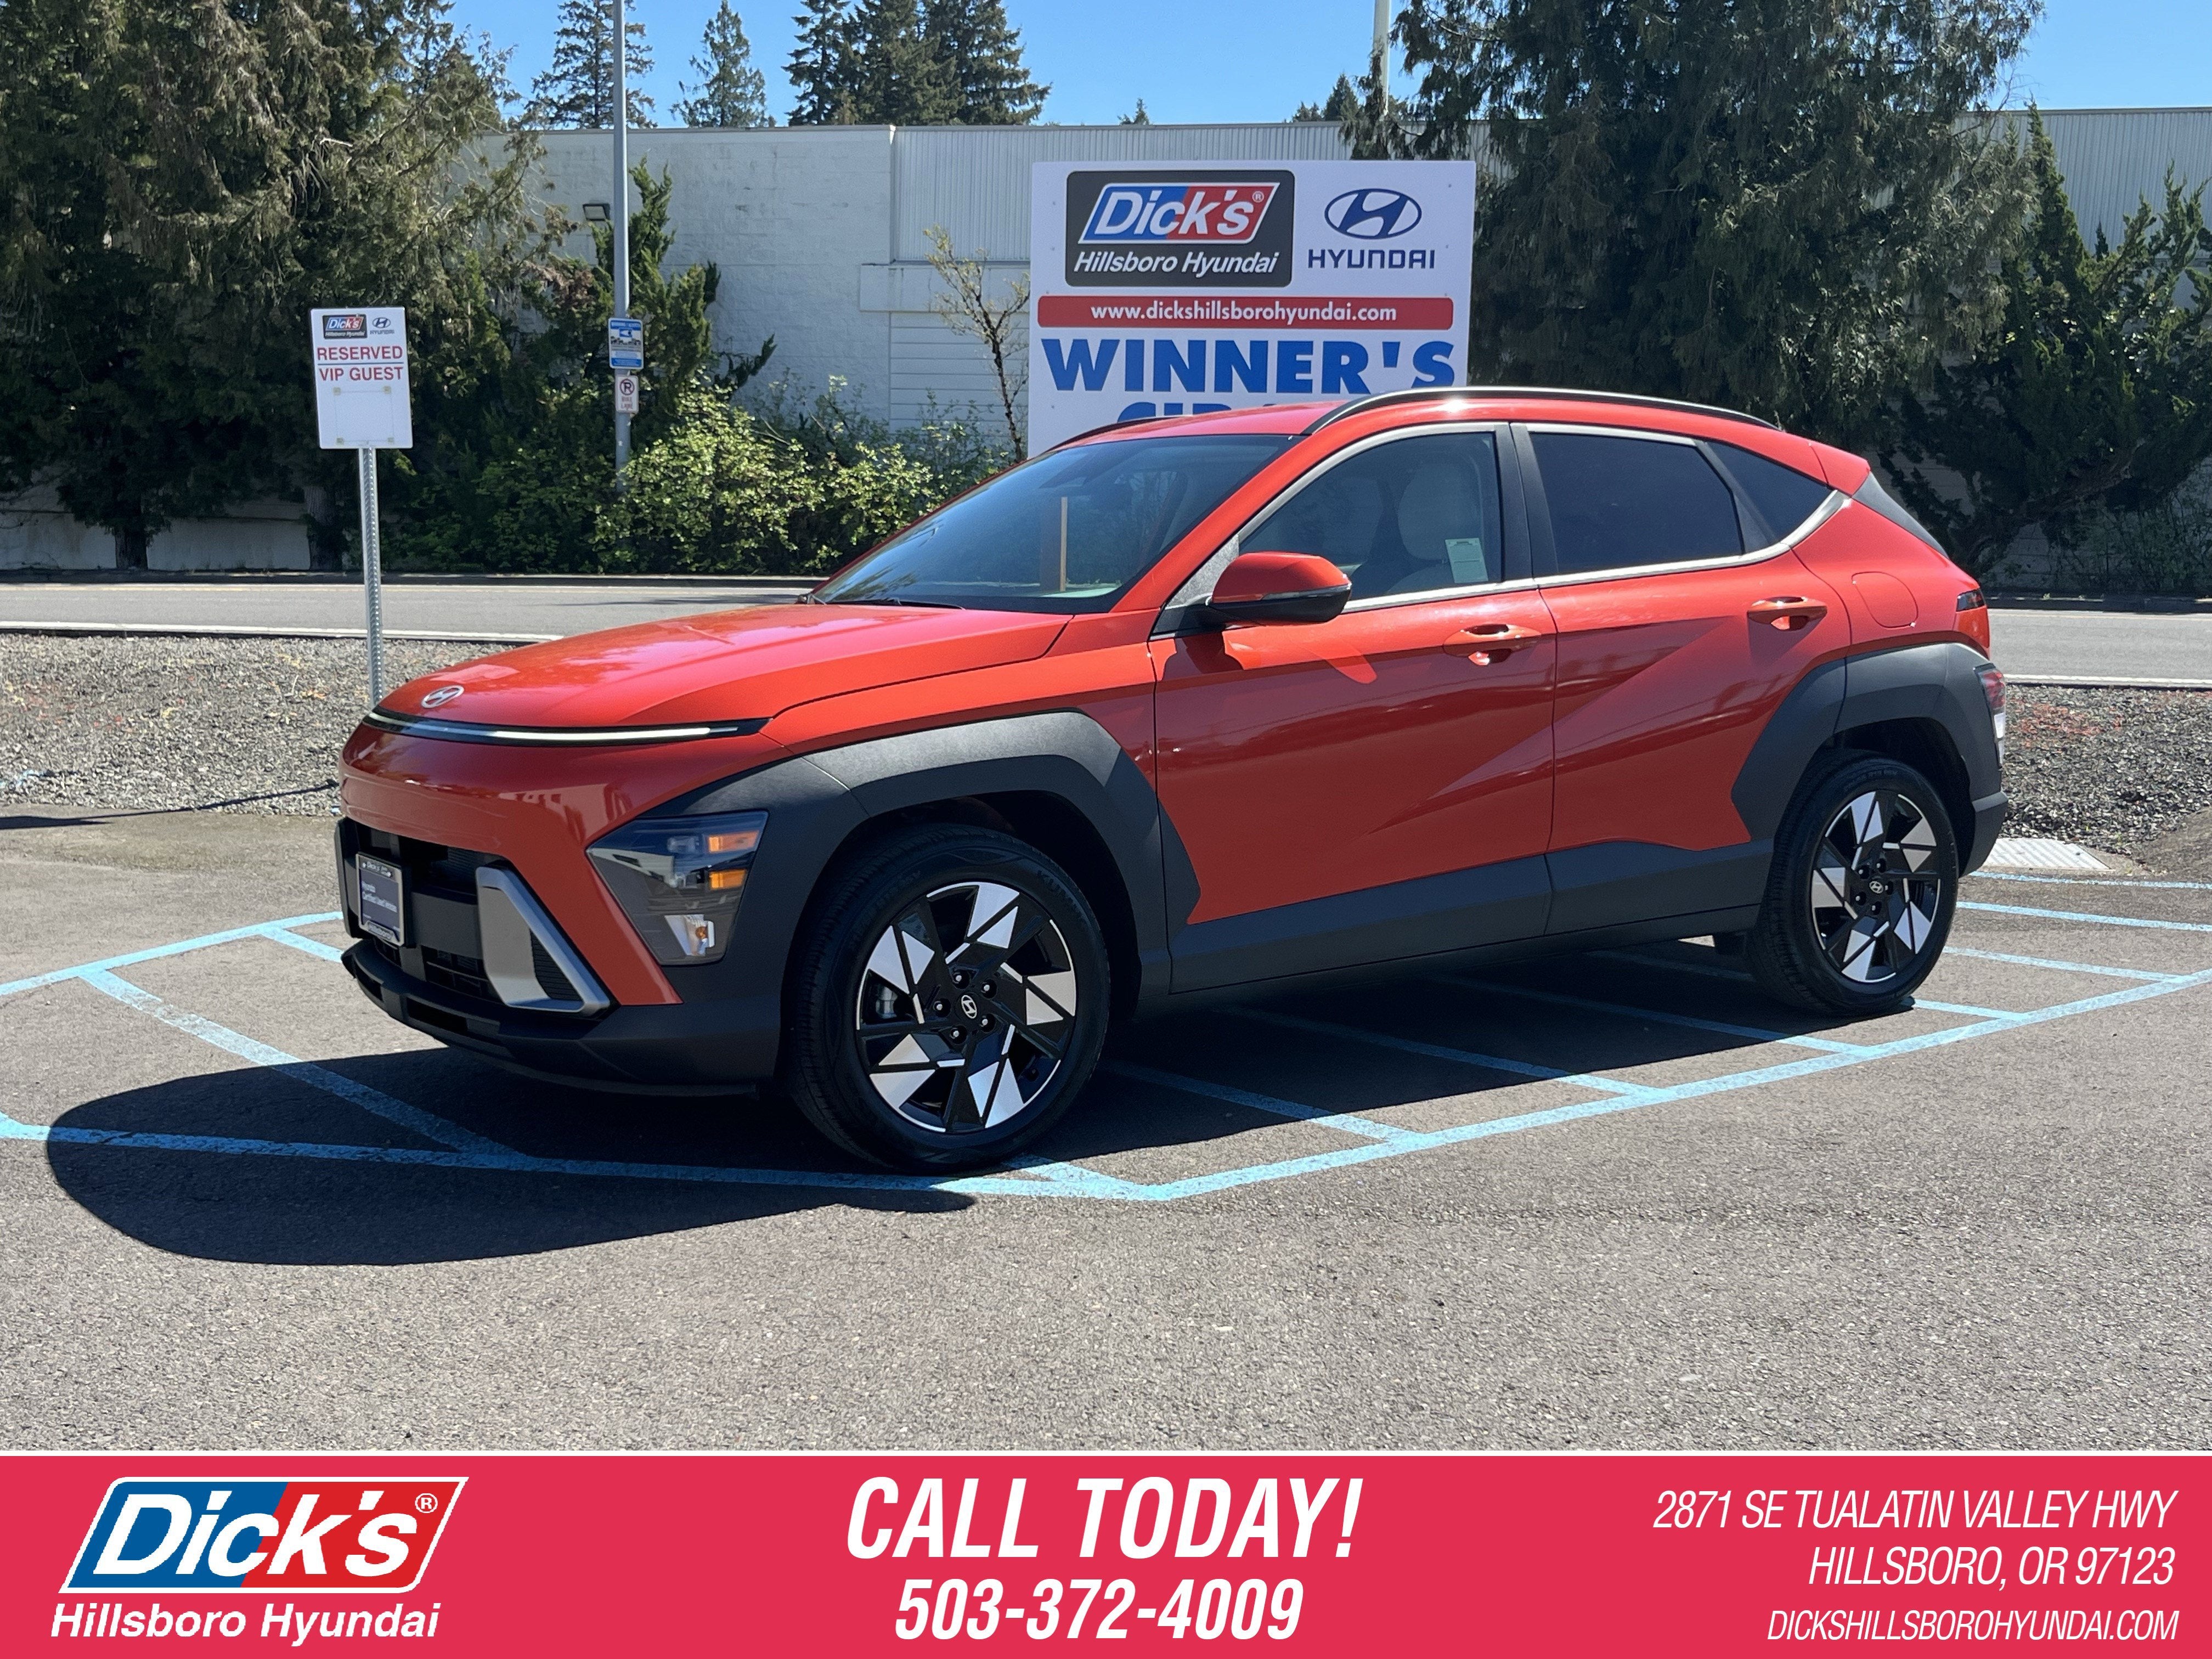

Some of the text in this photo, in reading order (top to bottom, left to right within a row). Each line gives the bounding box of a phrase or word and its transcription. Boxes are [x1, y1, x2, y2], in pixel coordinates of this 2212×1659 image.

[1094, 189, 1255, 236] Dick's
[1074, 251, 1280, 278] Hillsboro Hyundai
[1308, 249, 1436, 269] HYUNDAI
[1091, 300, 1397, 325] www.dickshillsborohyundai.com
[317, 346, 403, 360] RESERVED
[319, 367, 403, 381] VIP GUEST
[1041, 338, 1456, 394] WINNER'S
